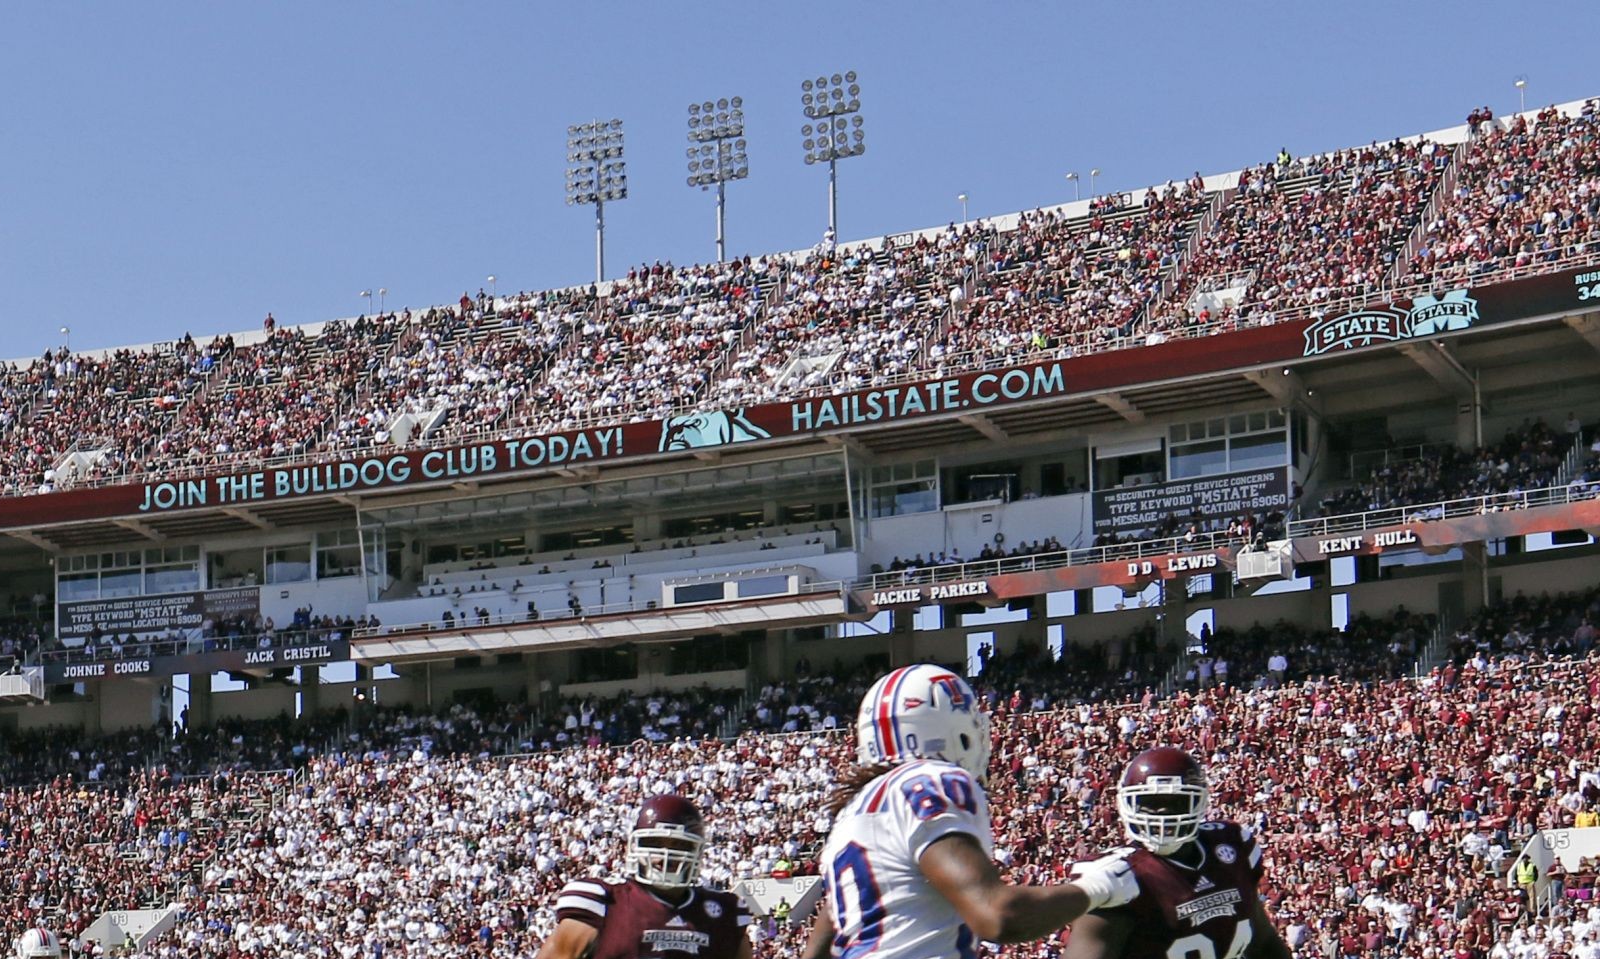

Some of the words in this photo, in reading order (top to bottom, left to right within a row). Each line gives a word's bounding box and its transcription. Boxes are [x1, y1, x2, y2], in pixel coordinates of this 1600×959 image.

[1418, 303, 1464, 323] STATE
[1323, 315, 1390, 343] STATE
[792, 364, 1065, 431] HAILSTATE.COM
[139, 480, 206, 511] JOIN
[216, 473, 264, 502] THE
[276, 456, 411, 496] BULLDOG
[421, 445, 496, 478] CLUB
[505, 428, 623, 468] TODAY!
[1109, 502, 1137, 514] TYPE
[1140, 495, 1193, 511] KEYWORD
[1194, 483, 1266, 504] "MSTATE"
[1116, 489, 1156, 501] SECURITY
[1165, 484, 1192, 495] GUEST
[1193, 479, 1229, 491] SERVICE
[1230, 473, 1275, 486] CONCERNS
[1112, 512, 1158, 526] MESSAGE
[1252, 494, 1286, 508] 69050
[1318, 536, 1362, 553] KENT
[1374, 529, 1417, 547] HULL
[1128, 563, 1138, 576] D
[1142, 561, 1152, 575] D
[1168, 554, 1218, 572] LEWIS
[77, 603, 107, 613] SECURITY
[114, 601, 133, 609] GUEST
[135, 598, 161, 607] SERVICE
[162, 596, 194, 605] CONCERNS
[871, 588, 921, 605] JACKIE
[930, 581, 988, 600] PARKER
[71, 614, 91, 623] TYPE
[94, 610, 134, 621] KEYWORD
[135, 605, 188, 618] "MSTATE"
[73, 622, 108, 633] MESSGE
[132, 617, 169, 628] LOCATION
[177, 614, 202, 625] 69050
[245, 650, 275, 663] JACK
[284, 645, 331, 660] CRISTIL
[63, 664, 105, 678] JOHNIE
[114, 661, 150, 674] COOKS
[901, 770, 978, 820] 80
[1543, 831, 1571, 850] 05
[1178, 890, 1241, 918] MISSISSIPPI
[1198, 907, 1229, 921] STATE
[111, 912, 128, 926] 03
